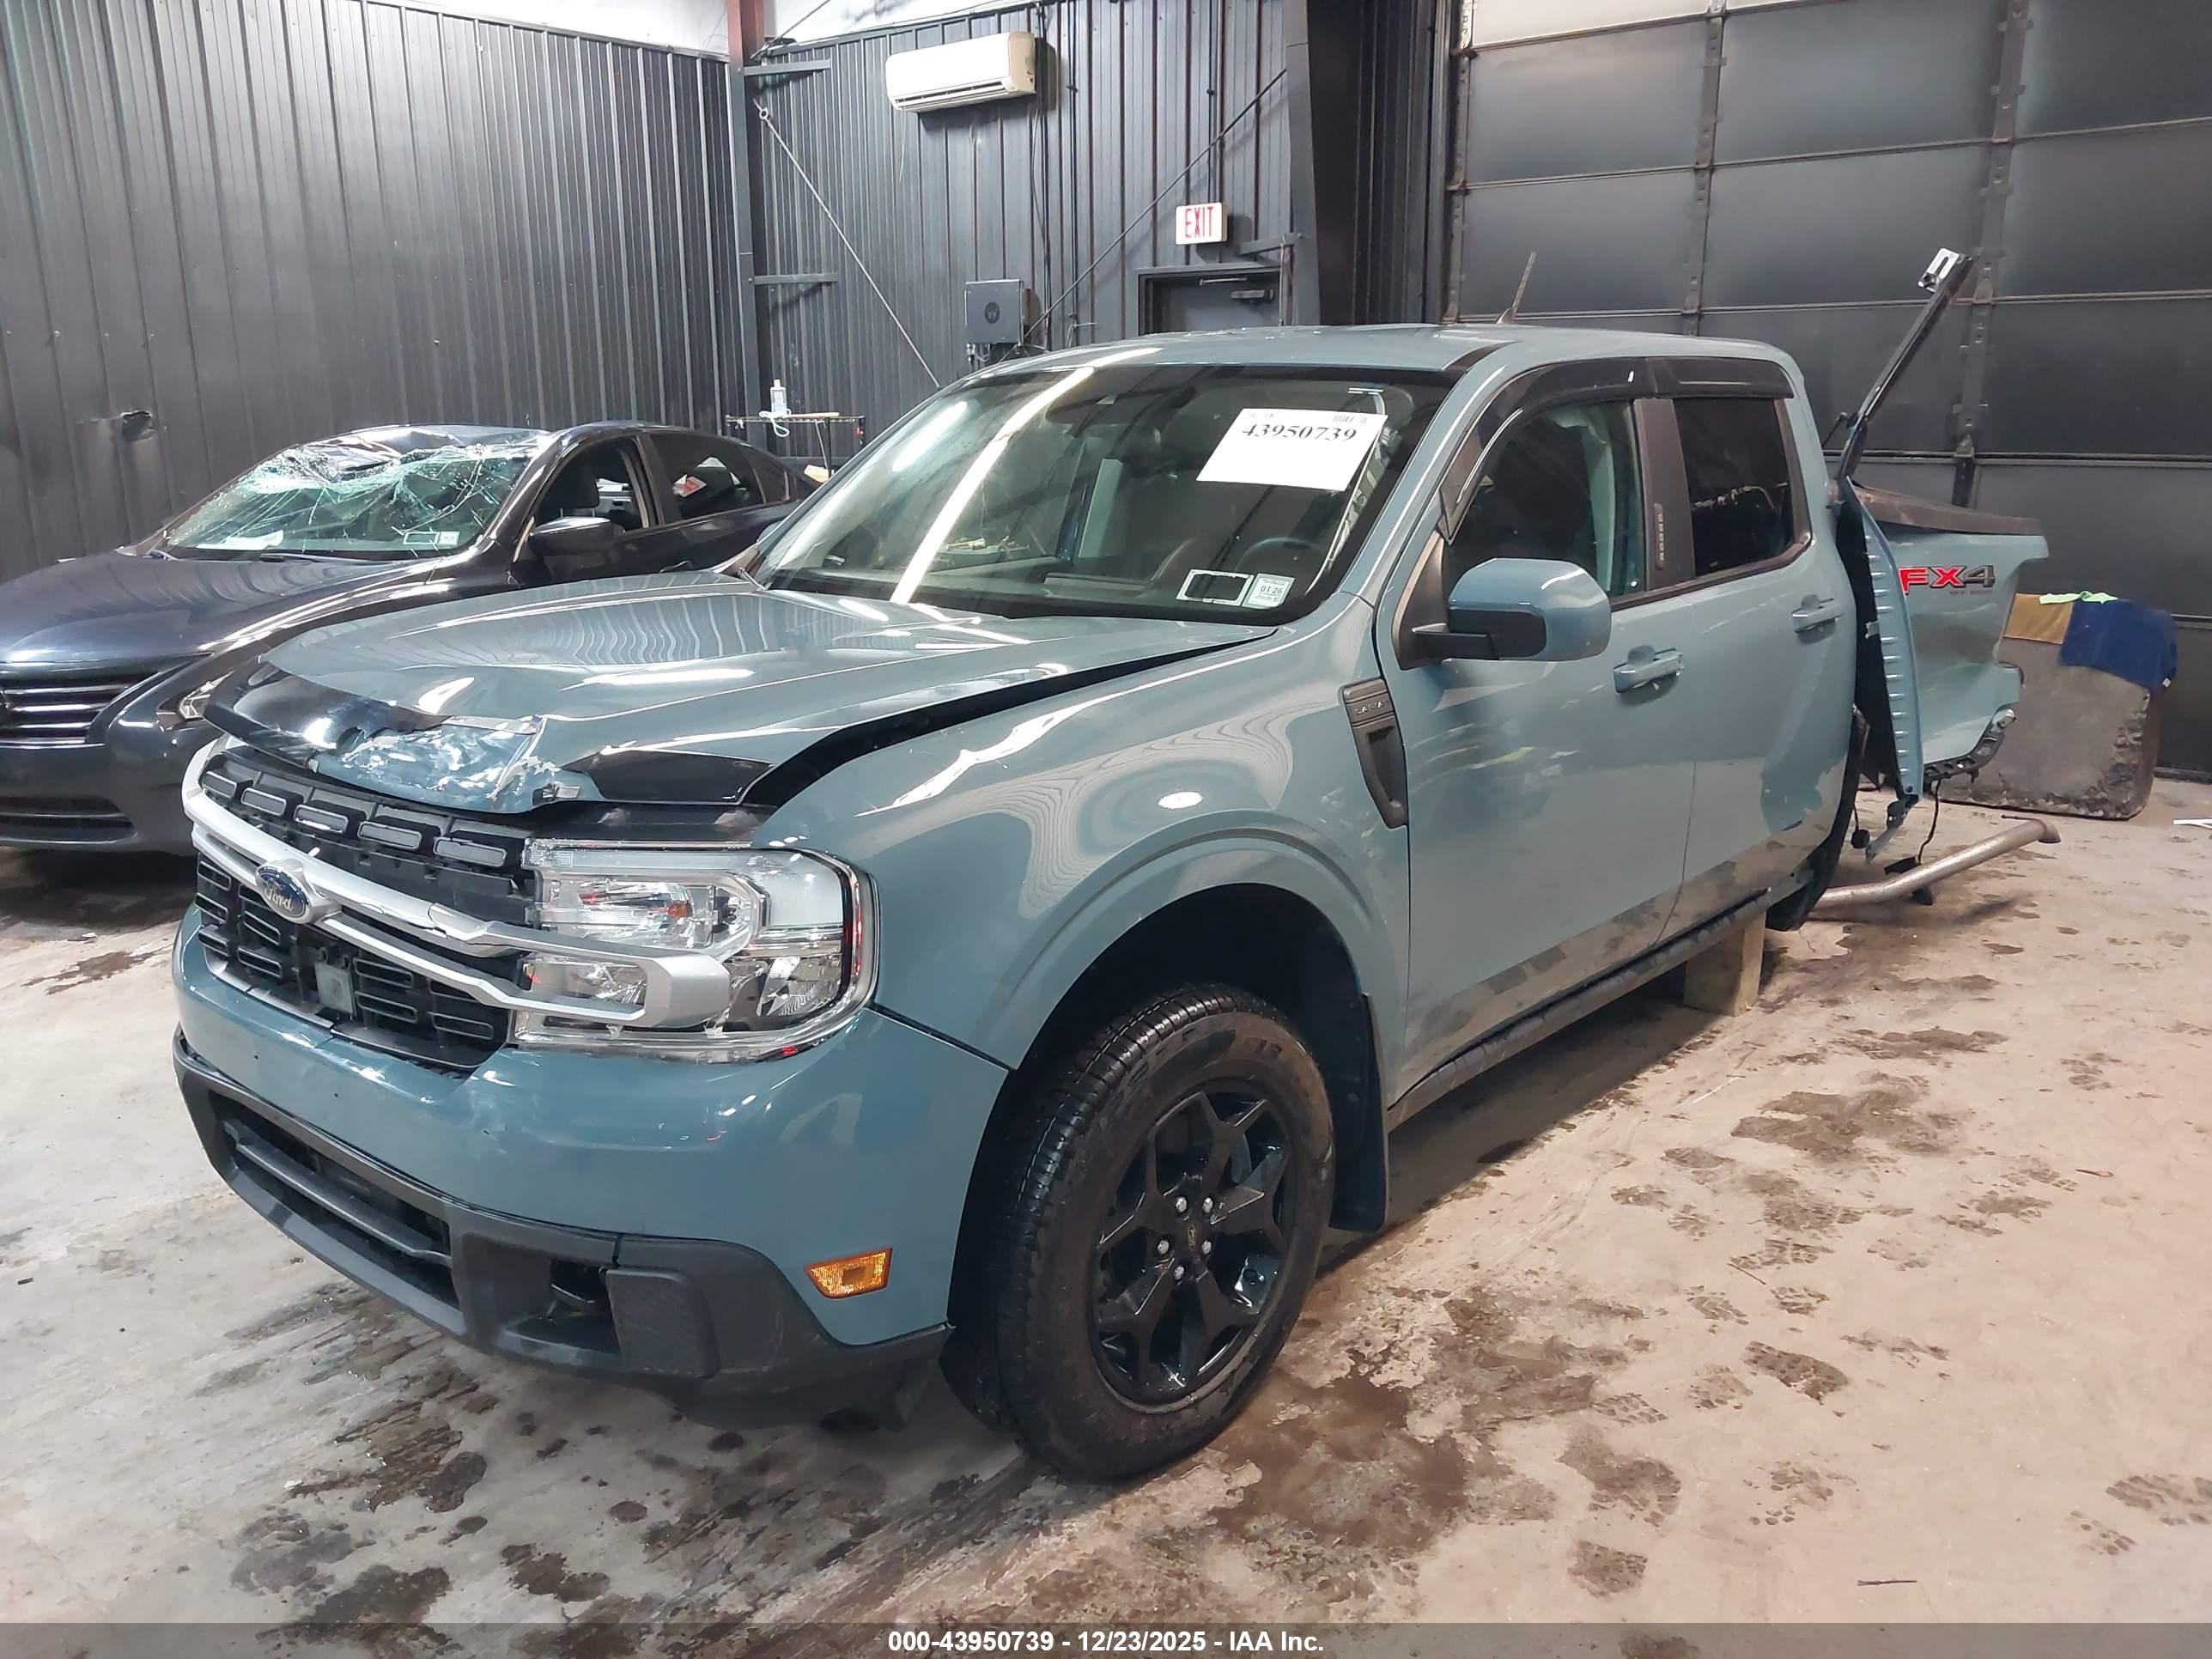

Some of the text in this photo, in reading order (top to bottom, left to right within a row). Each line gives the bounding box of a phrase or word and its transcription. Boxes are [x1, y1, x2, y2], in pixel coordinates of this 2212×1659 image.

[1185, 206, 1214, 239] EXIT
[1242, 423, 1357, 441] 43950739
[1898, 565, 1996, 595] FX4
[263, 877, 295, 913] Ford
